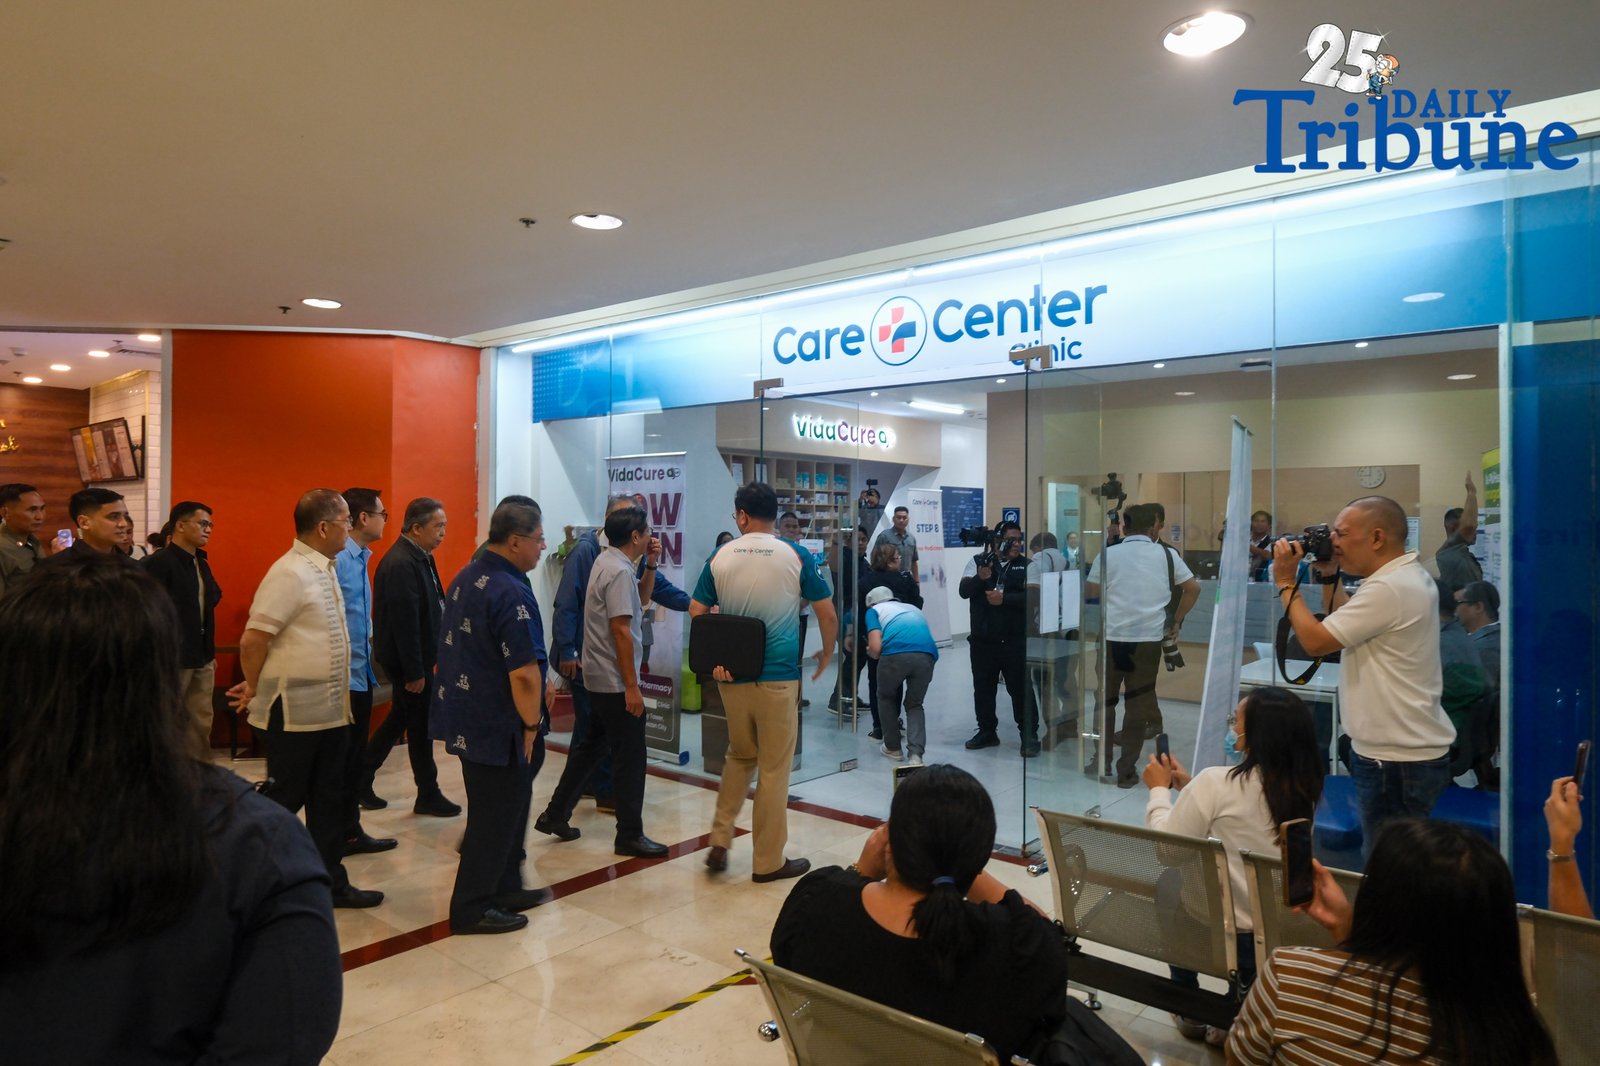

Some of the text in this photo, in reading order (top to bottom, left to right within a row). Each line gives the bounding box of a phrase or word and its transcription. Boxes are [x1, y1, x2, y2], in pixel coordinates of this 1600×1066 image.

[773, 284, 1107, 365] Care Center
[795, 417, 876, 445] VidaCure
[608, 467, 665, 482] VidaCure
[916, 523, 933, 533] STEP
